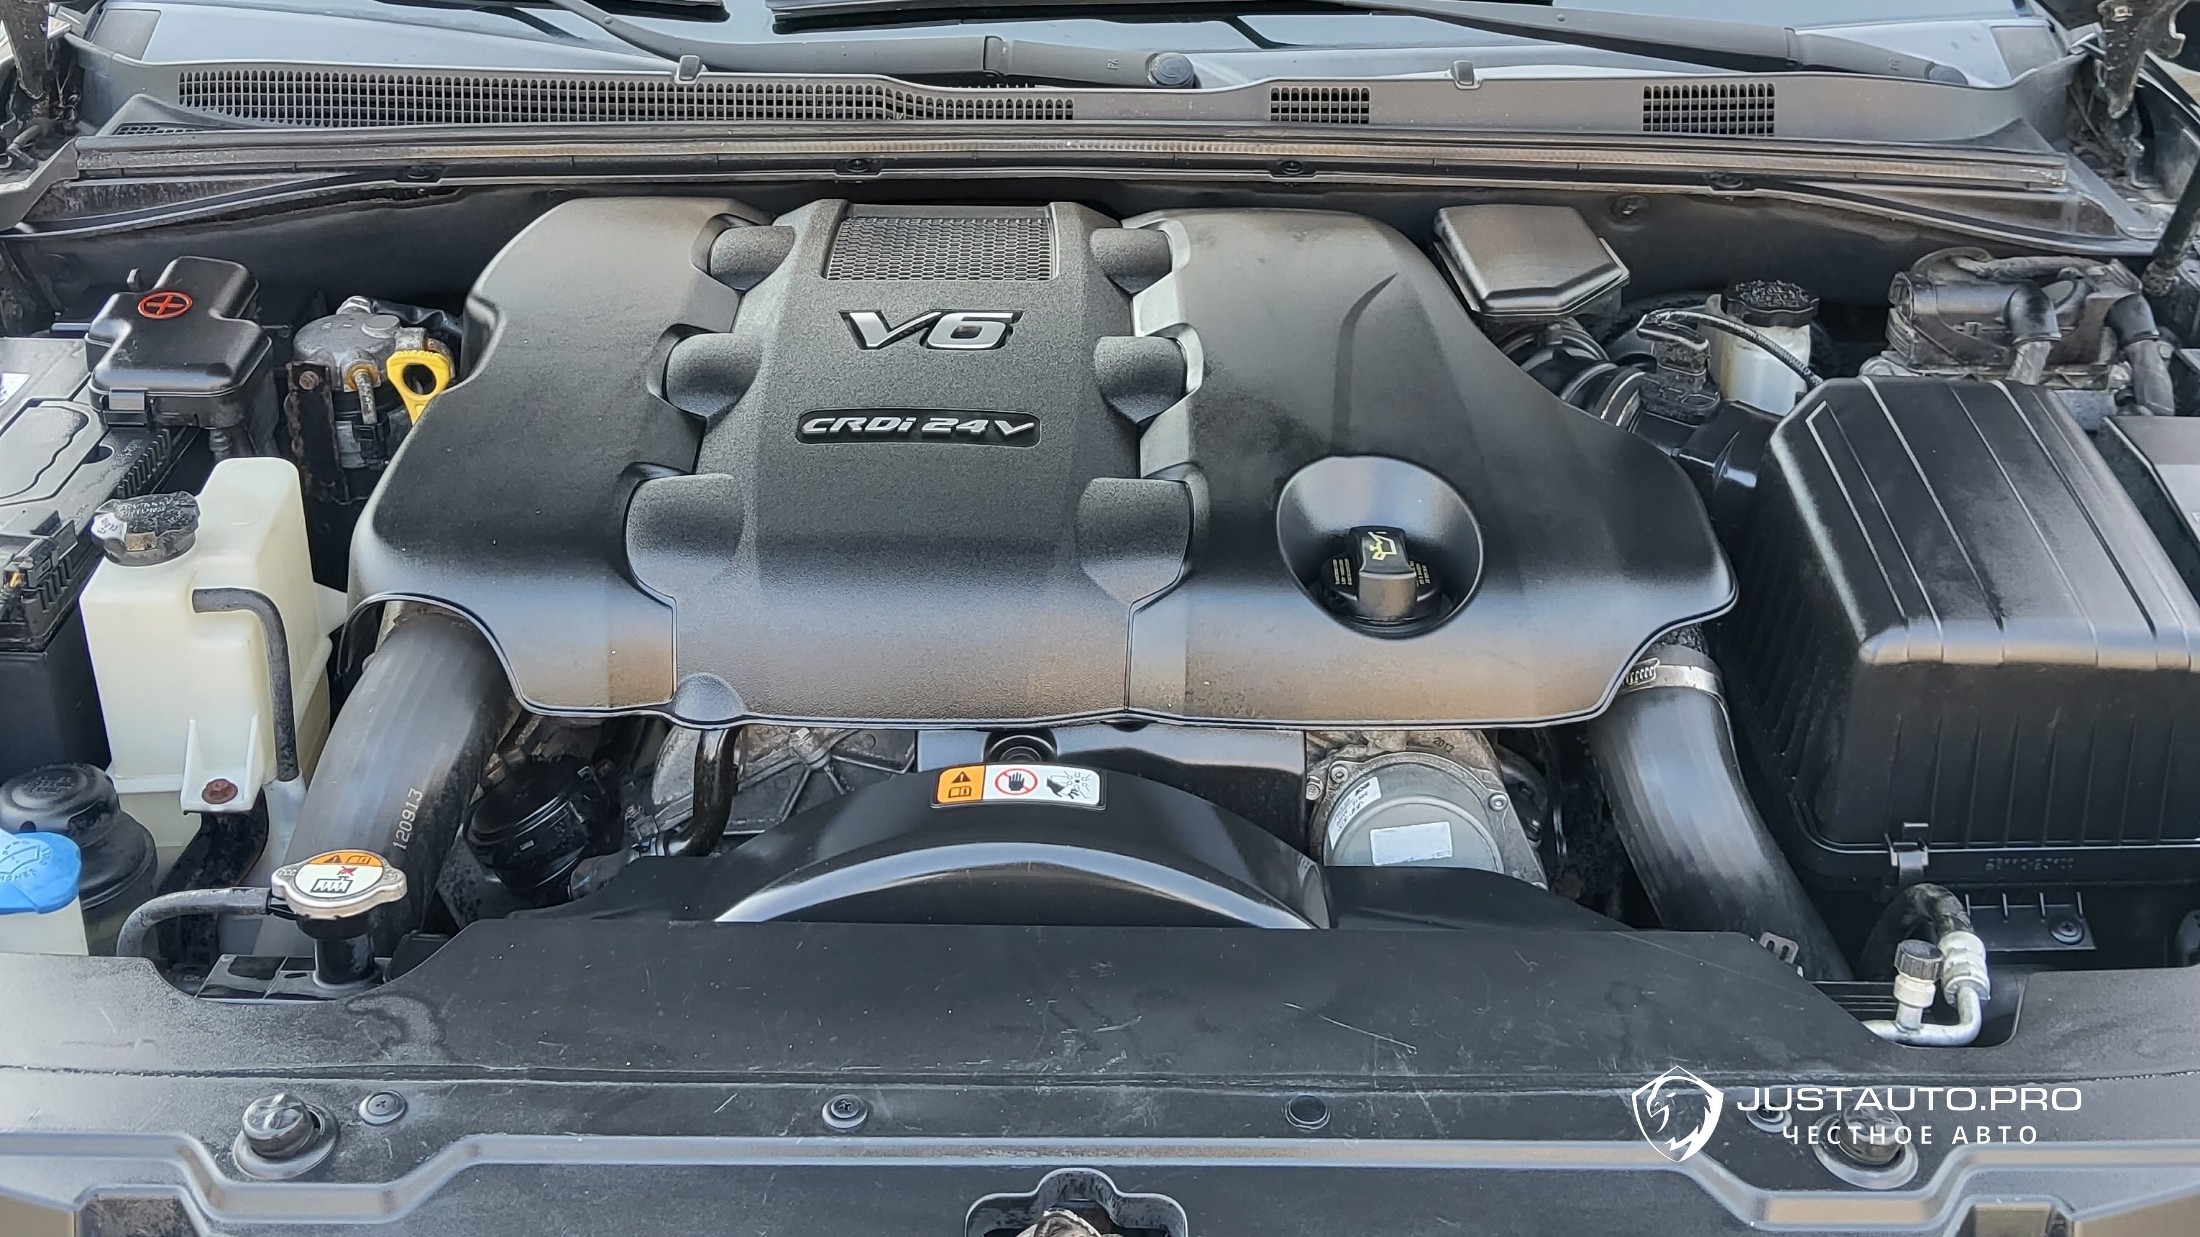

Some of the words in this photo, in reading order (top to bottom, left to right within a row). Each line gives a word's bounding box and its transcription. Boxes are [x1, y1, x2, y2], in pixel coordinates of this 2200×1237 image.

[842, 310, 1020, 350] V6
[801, 416, 917, 434] CRDi
[921, 416, 1035, 437] 24V
[392, 787, 423, 851] 120913
